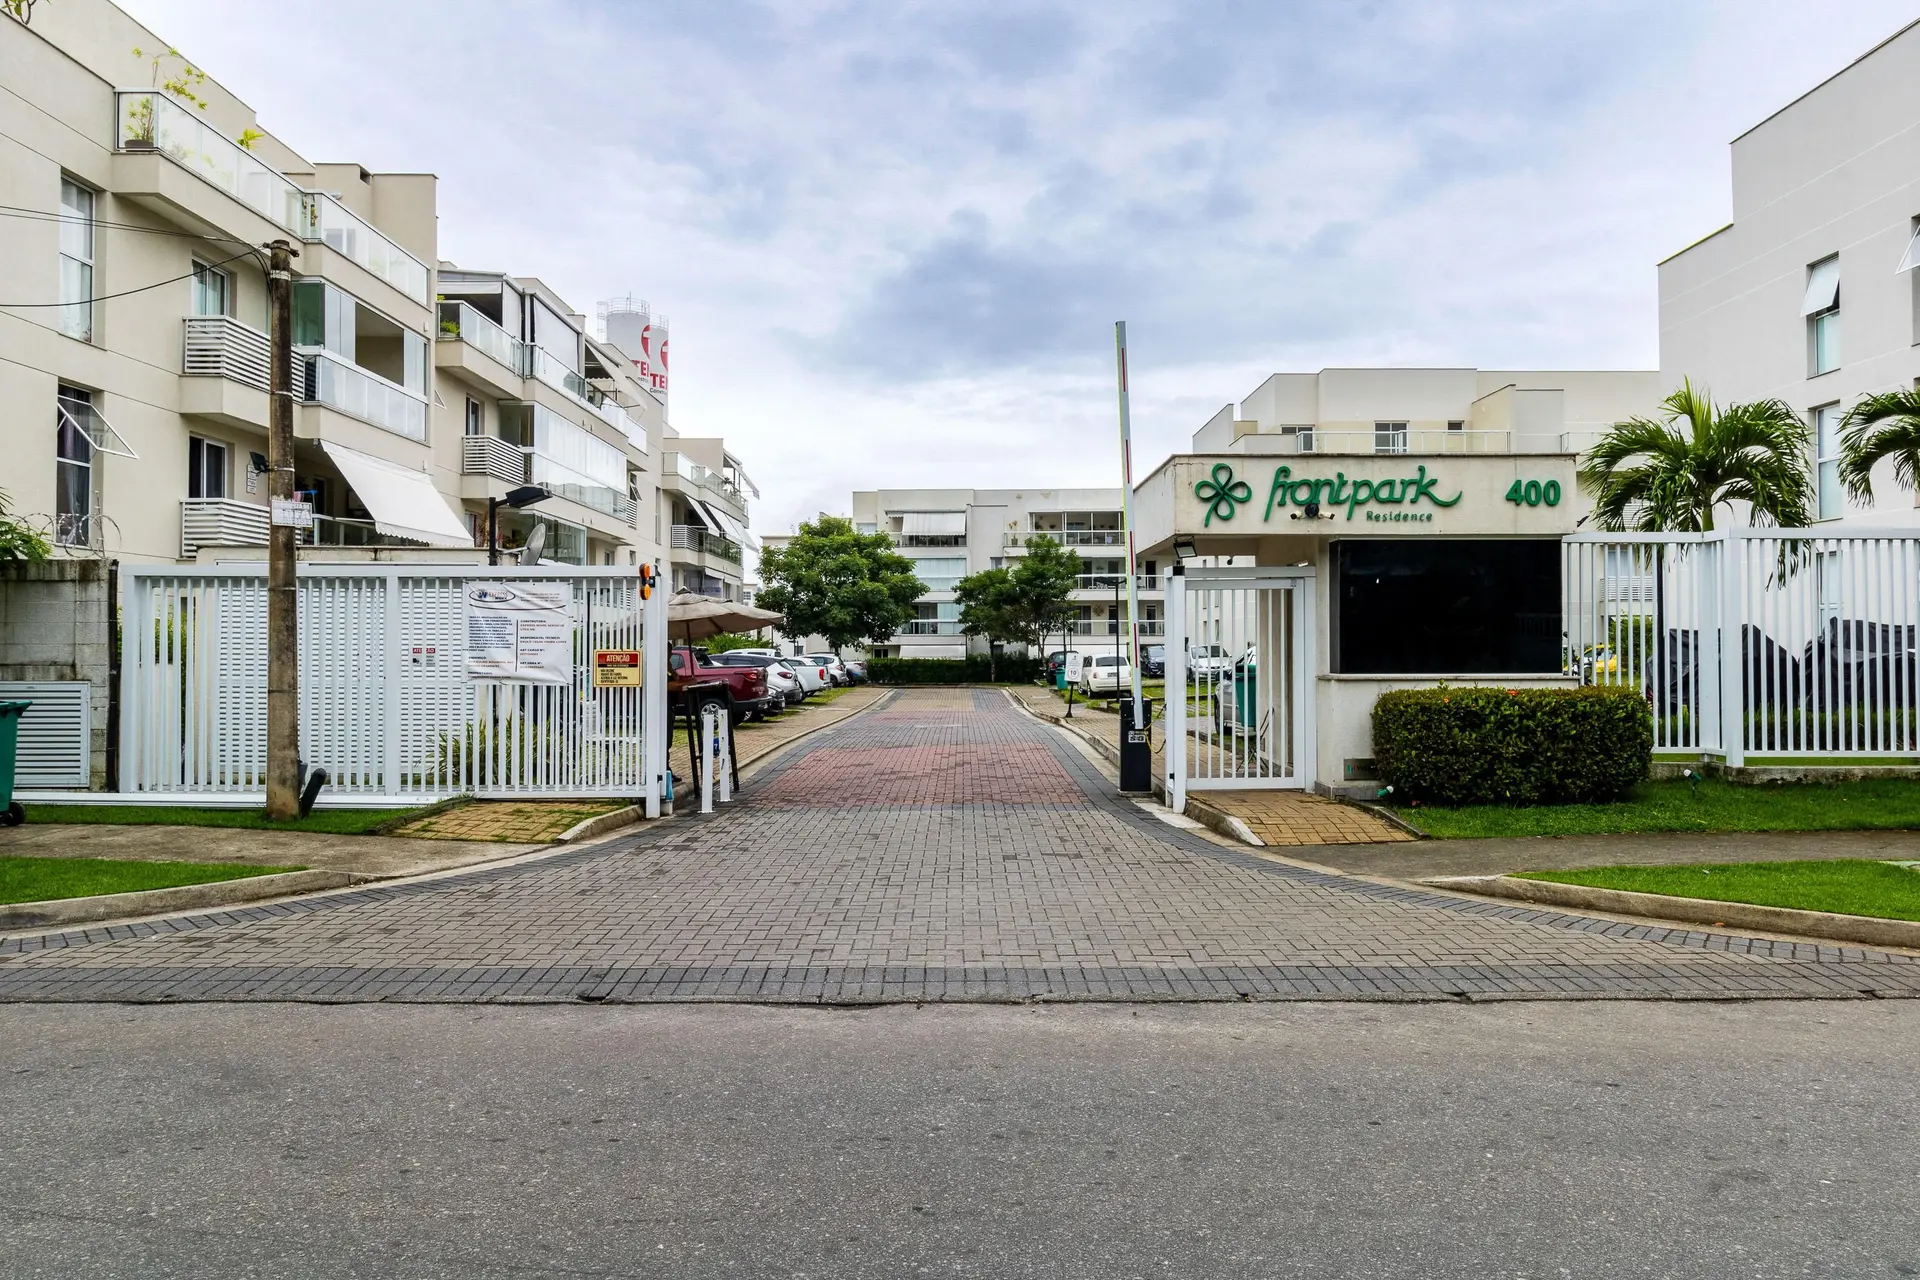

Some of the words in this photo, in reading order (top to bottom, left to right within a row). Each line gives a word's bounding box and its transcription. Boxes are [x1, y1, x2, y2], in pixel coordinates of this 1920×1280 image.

[1505, 479, 1561, 507] 400
[1366, 510, 1433, 522] Residence
[606, 654, 630, 663] ATENÇÃO
